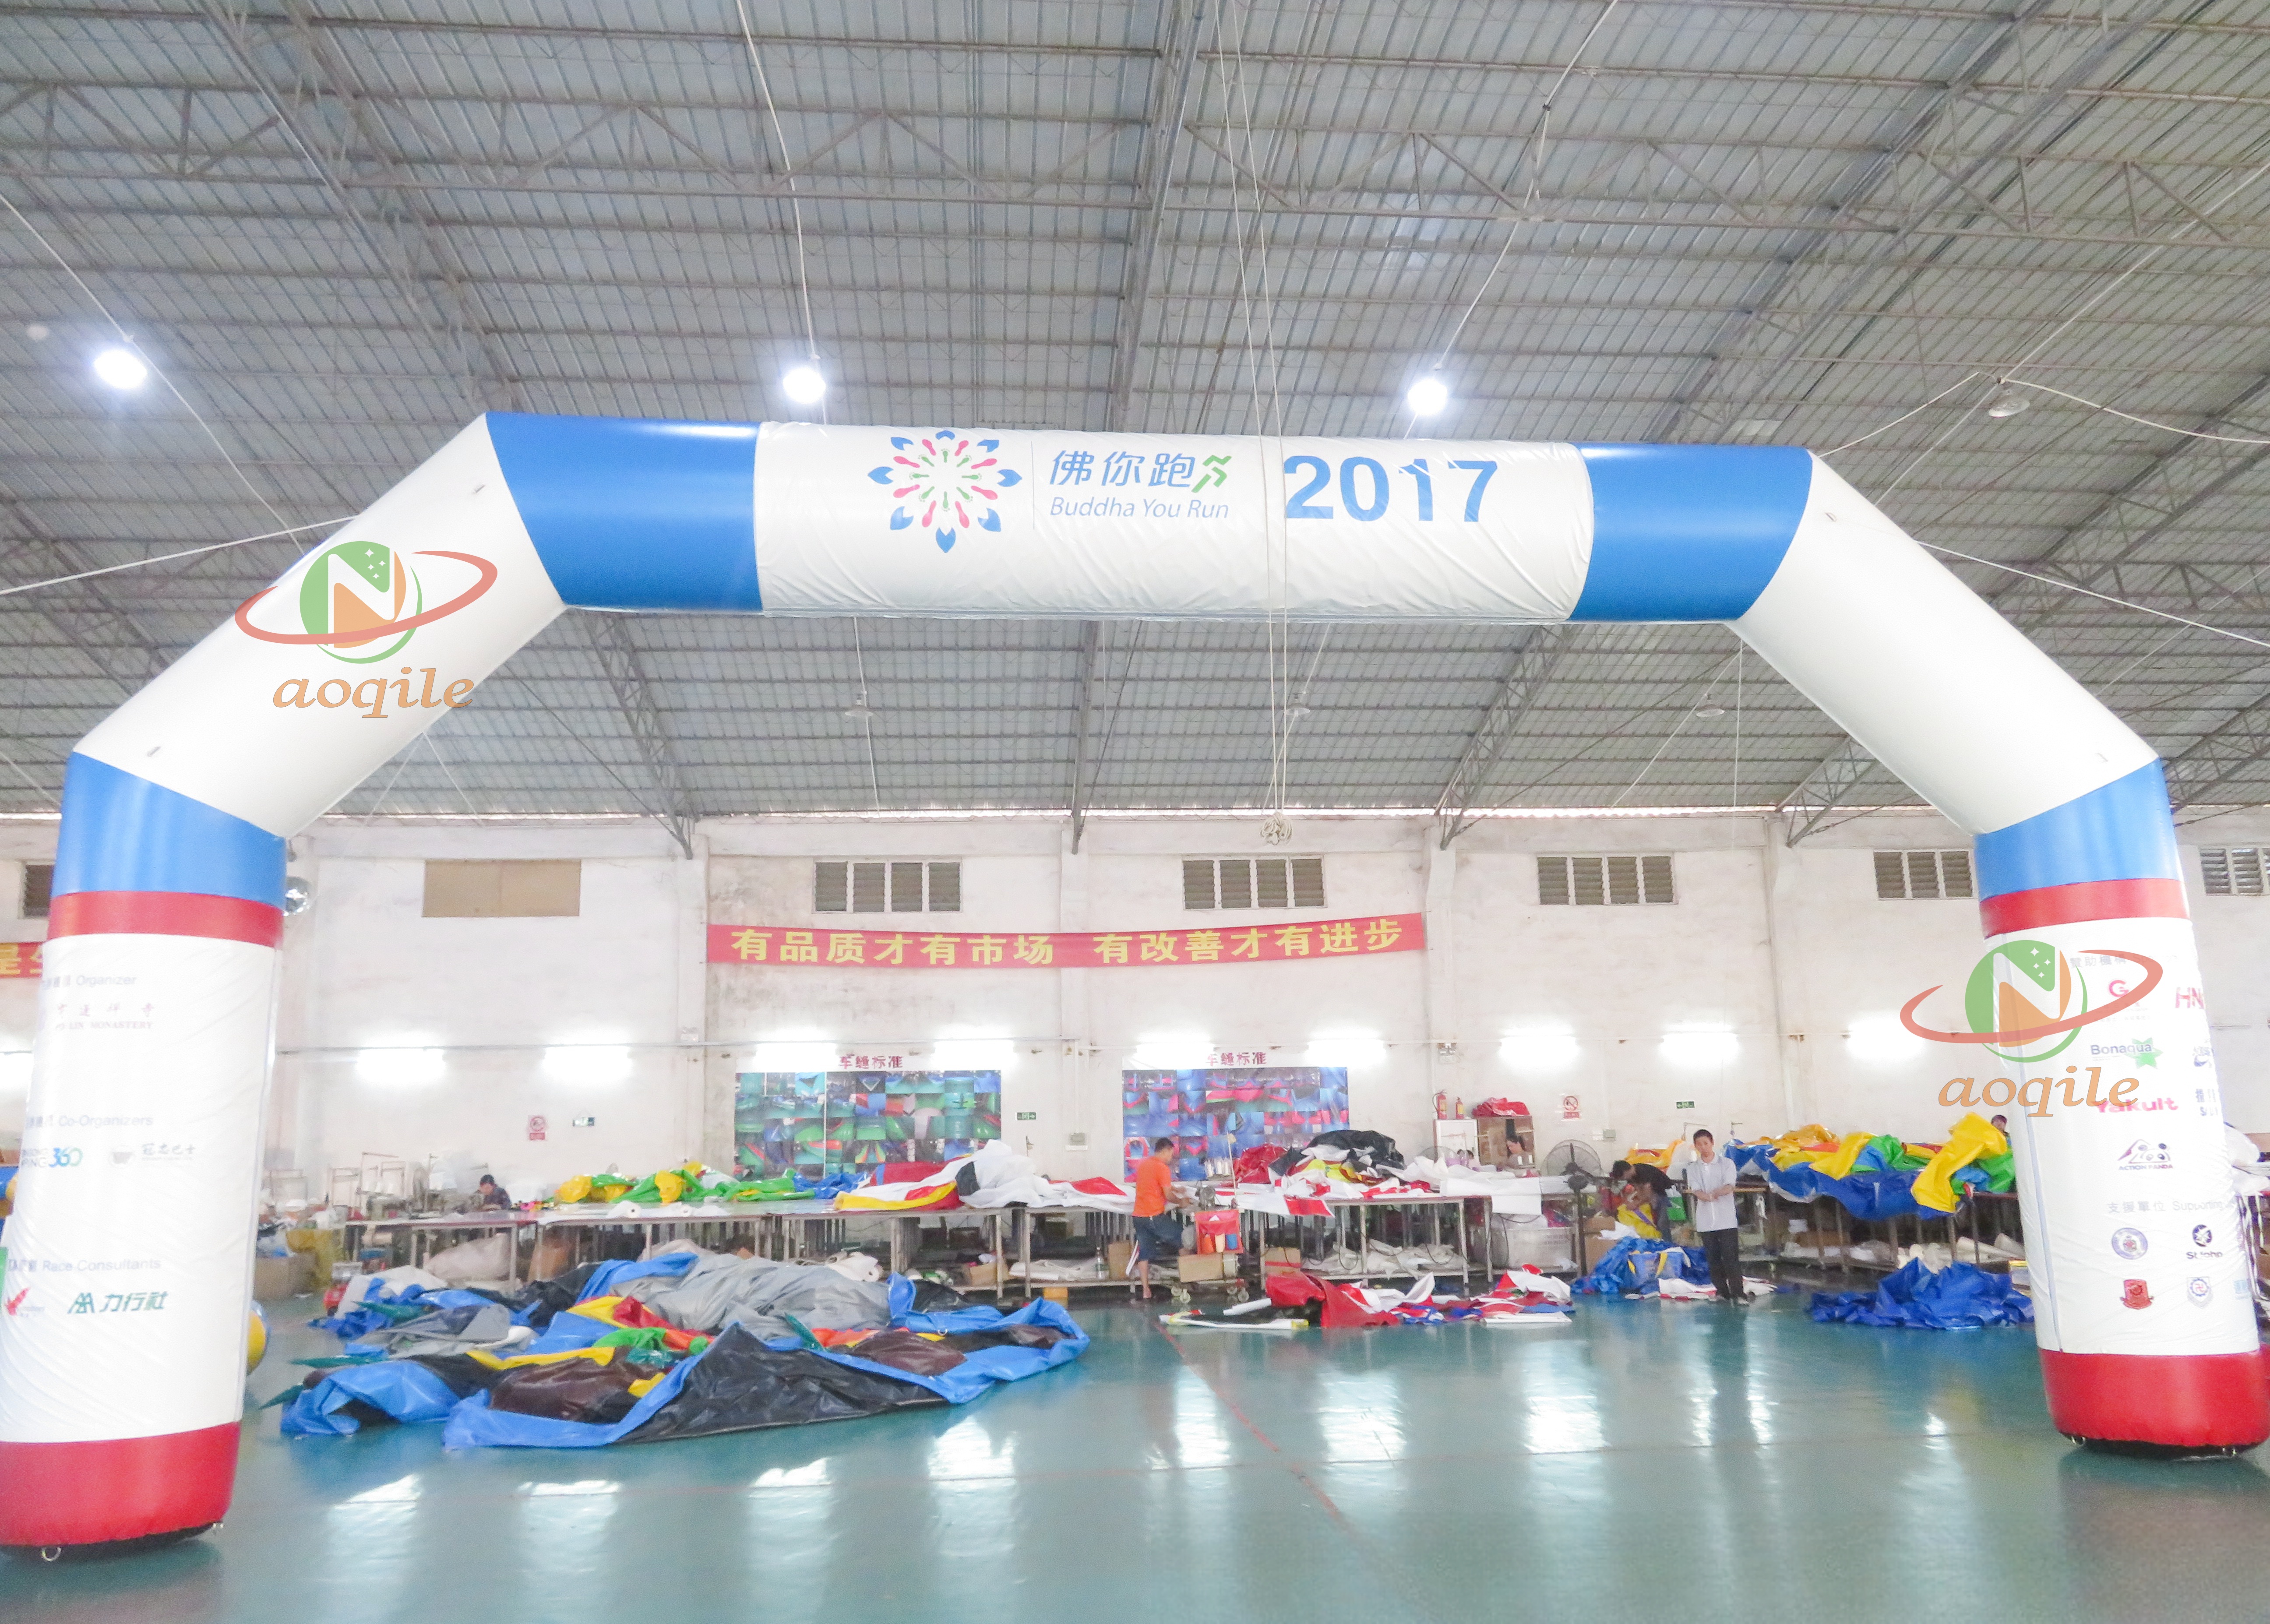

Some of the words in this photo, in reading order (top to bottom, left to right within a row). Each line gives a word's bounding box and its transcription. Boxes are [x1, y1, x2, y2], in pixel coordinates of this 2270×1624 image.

[1283, 455, 1498, 521] 2017
[1050, 497, 1135, 518] Buddha
[1143, 498, 1181, 518] You
[1187, 499, 1229, 518] Run
[732, 929, 1054, 965] 有品质才有市场
[1094, 918, 1403, 964] 有改善才有进步
[76, 975, 137, 987] Organizer
[2090, 1043, 2152, 1056] Bonaqua
[2093, 1098, 2178, 1113] Yakult
[59, 1115, 154, 1128] Co-Organizers
[42, 1260, 73, 1272] Race
[77, 1258, 161, 1272] Consultants
